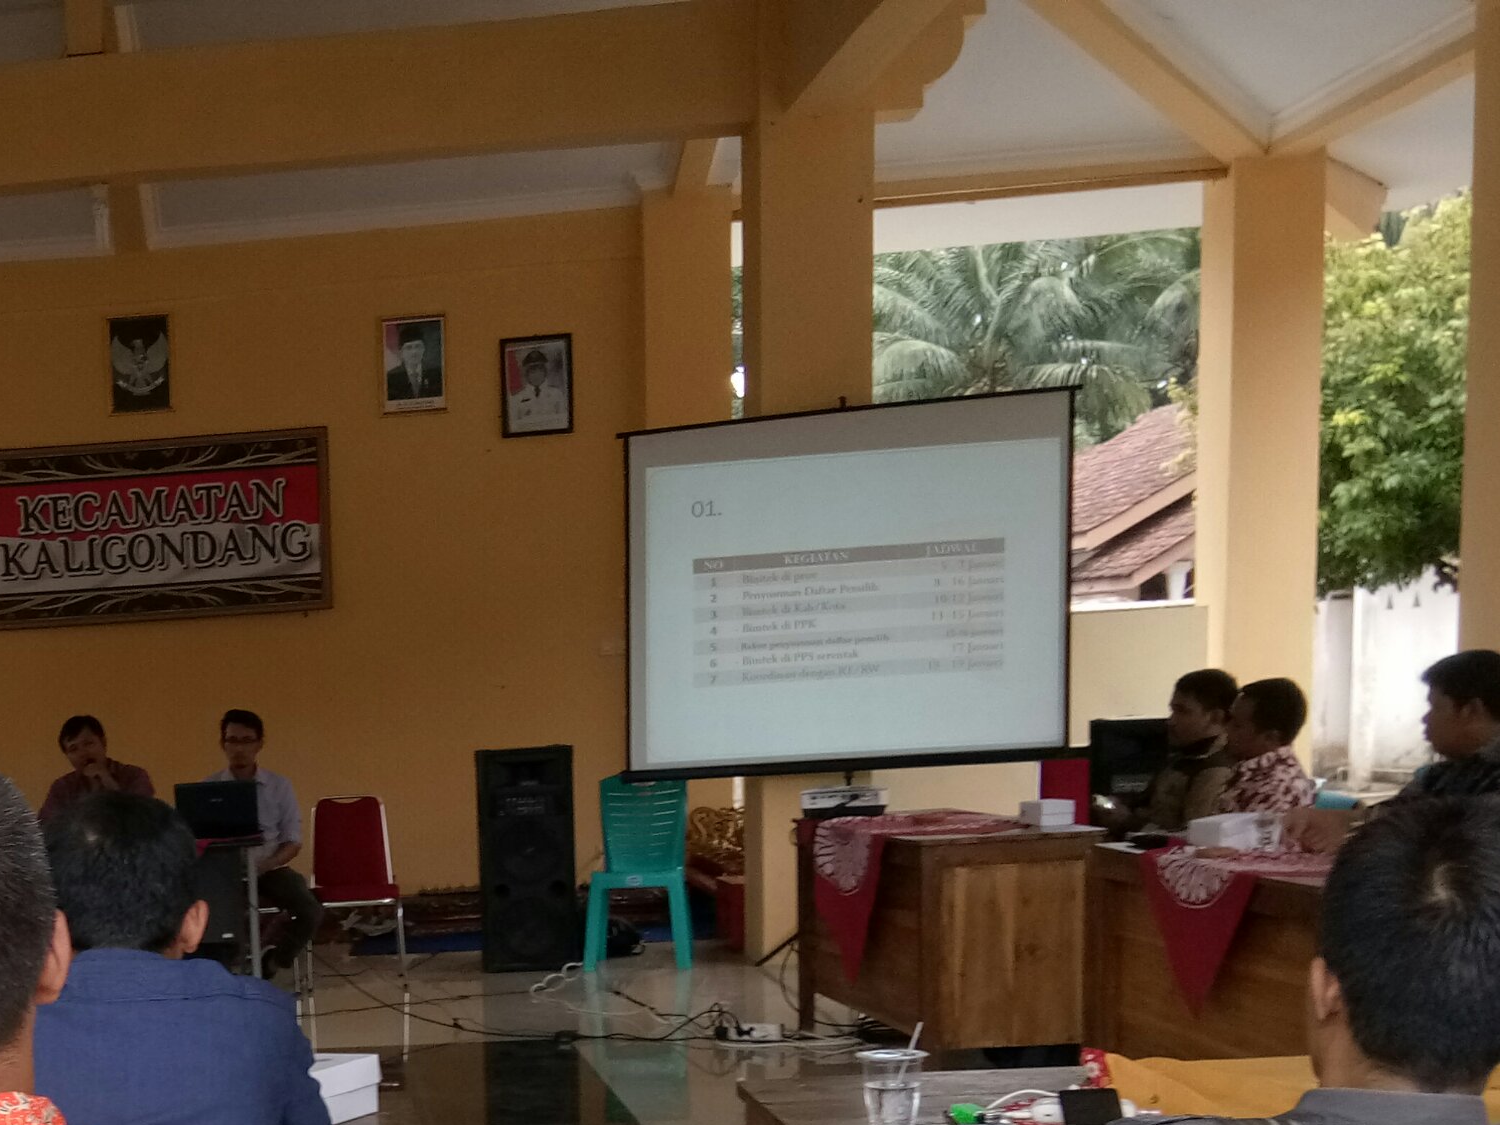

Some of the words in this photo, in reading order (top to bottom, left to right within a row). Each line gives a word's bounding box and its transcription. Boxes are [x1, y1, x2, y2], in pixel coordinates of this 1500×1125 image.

[19, 478, 286, 535] KECAMATAN
[691, 500, 723, 519] 01.
[0, 523, 313, 581] KALIGONDANG
[783, 550, 850, 566] KEGIATAN
[926, 543, 977, 557] JADWAL
[709, 593, 718, 604] 2
[781, 621, 792, 631] di
[793, 618, 818, 630] PPK
[781, 652, 792, 663] di
